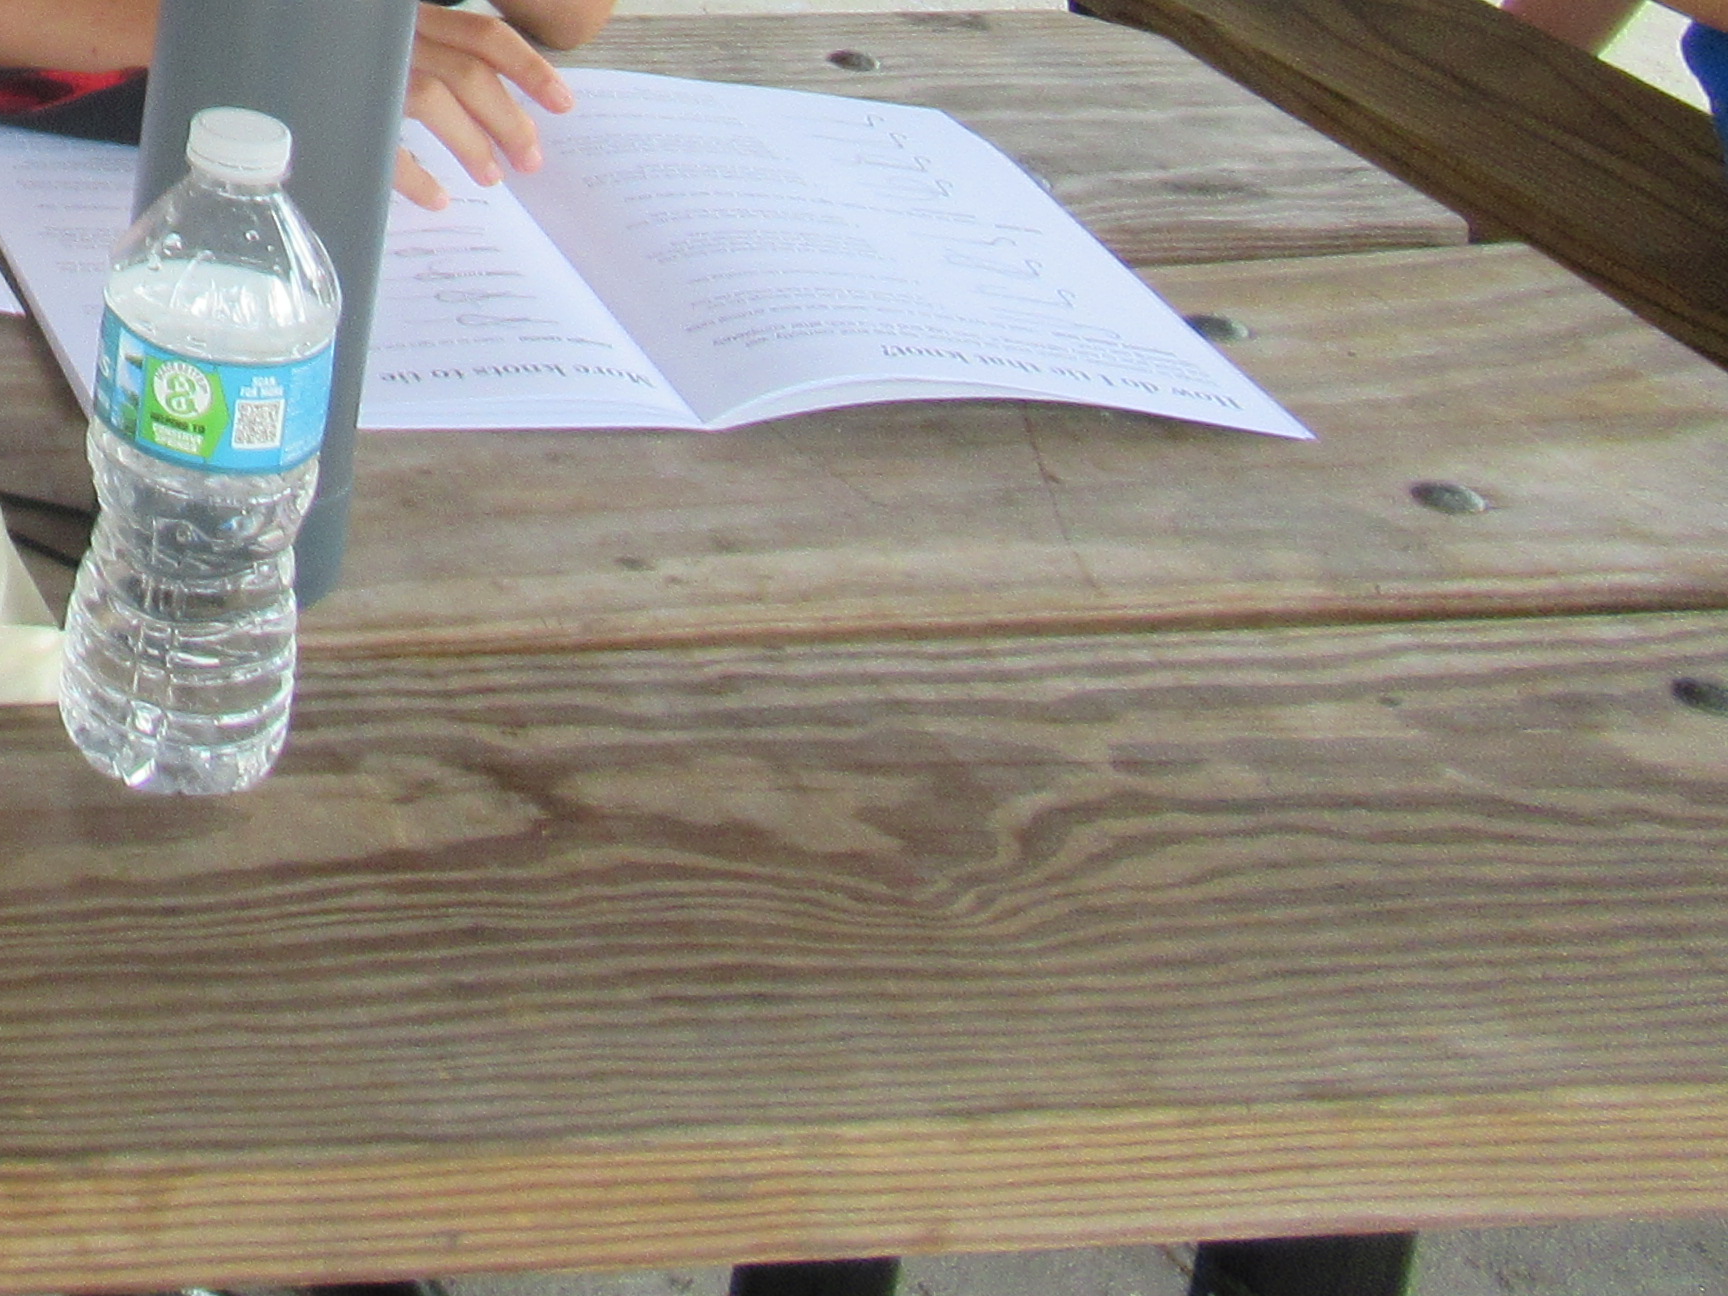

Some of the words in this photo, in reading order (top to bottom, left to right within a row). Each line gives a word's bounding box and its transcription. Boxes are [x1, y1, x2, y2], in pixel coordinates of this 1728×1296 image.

[429, 366, 465, 380] to
[470, 362, 567, 378] knots
[977, 354, 1042, 375] that
[378, 370, 423, 385] tie
[572, 363, 656, 389] More
[1049, 365, 1092, 383] tie
[1120, 376, 1159, 394] do
[1170, 385, 1245, 410] How
